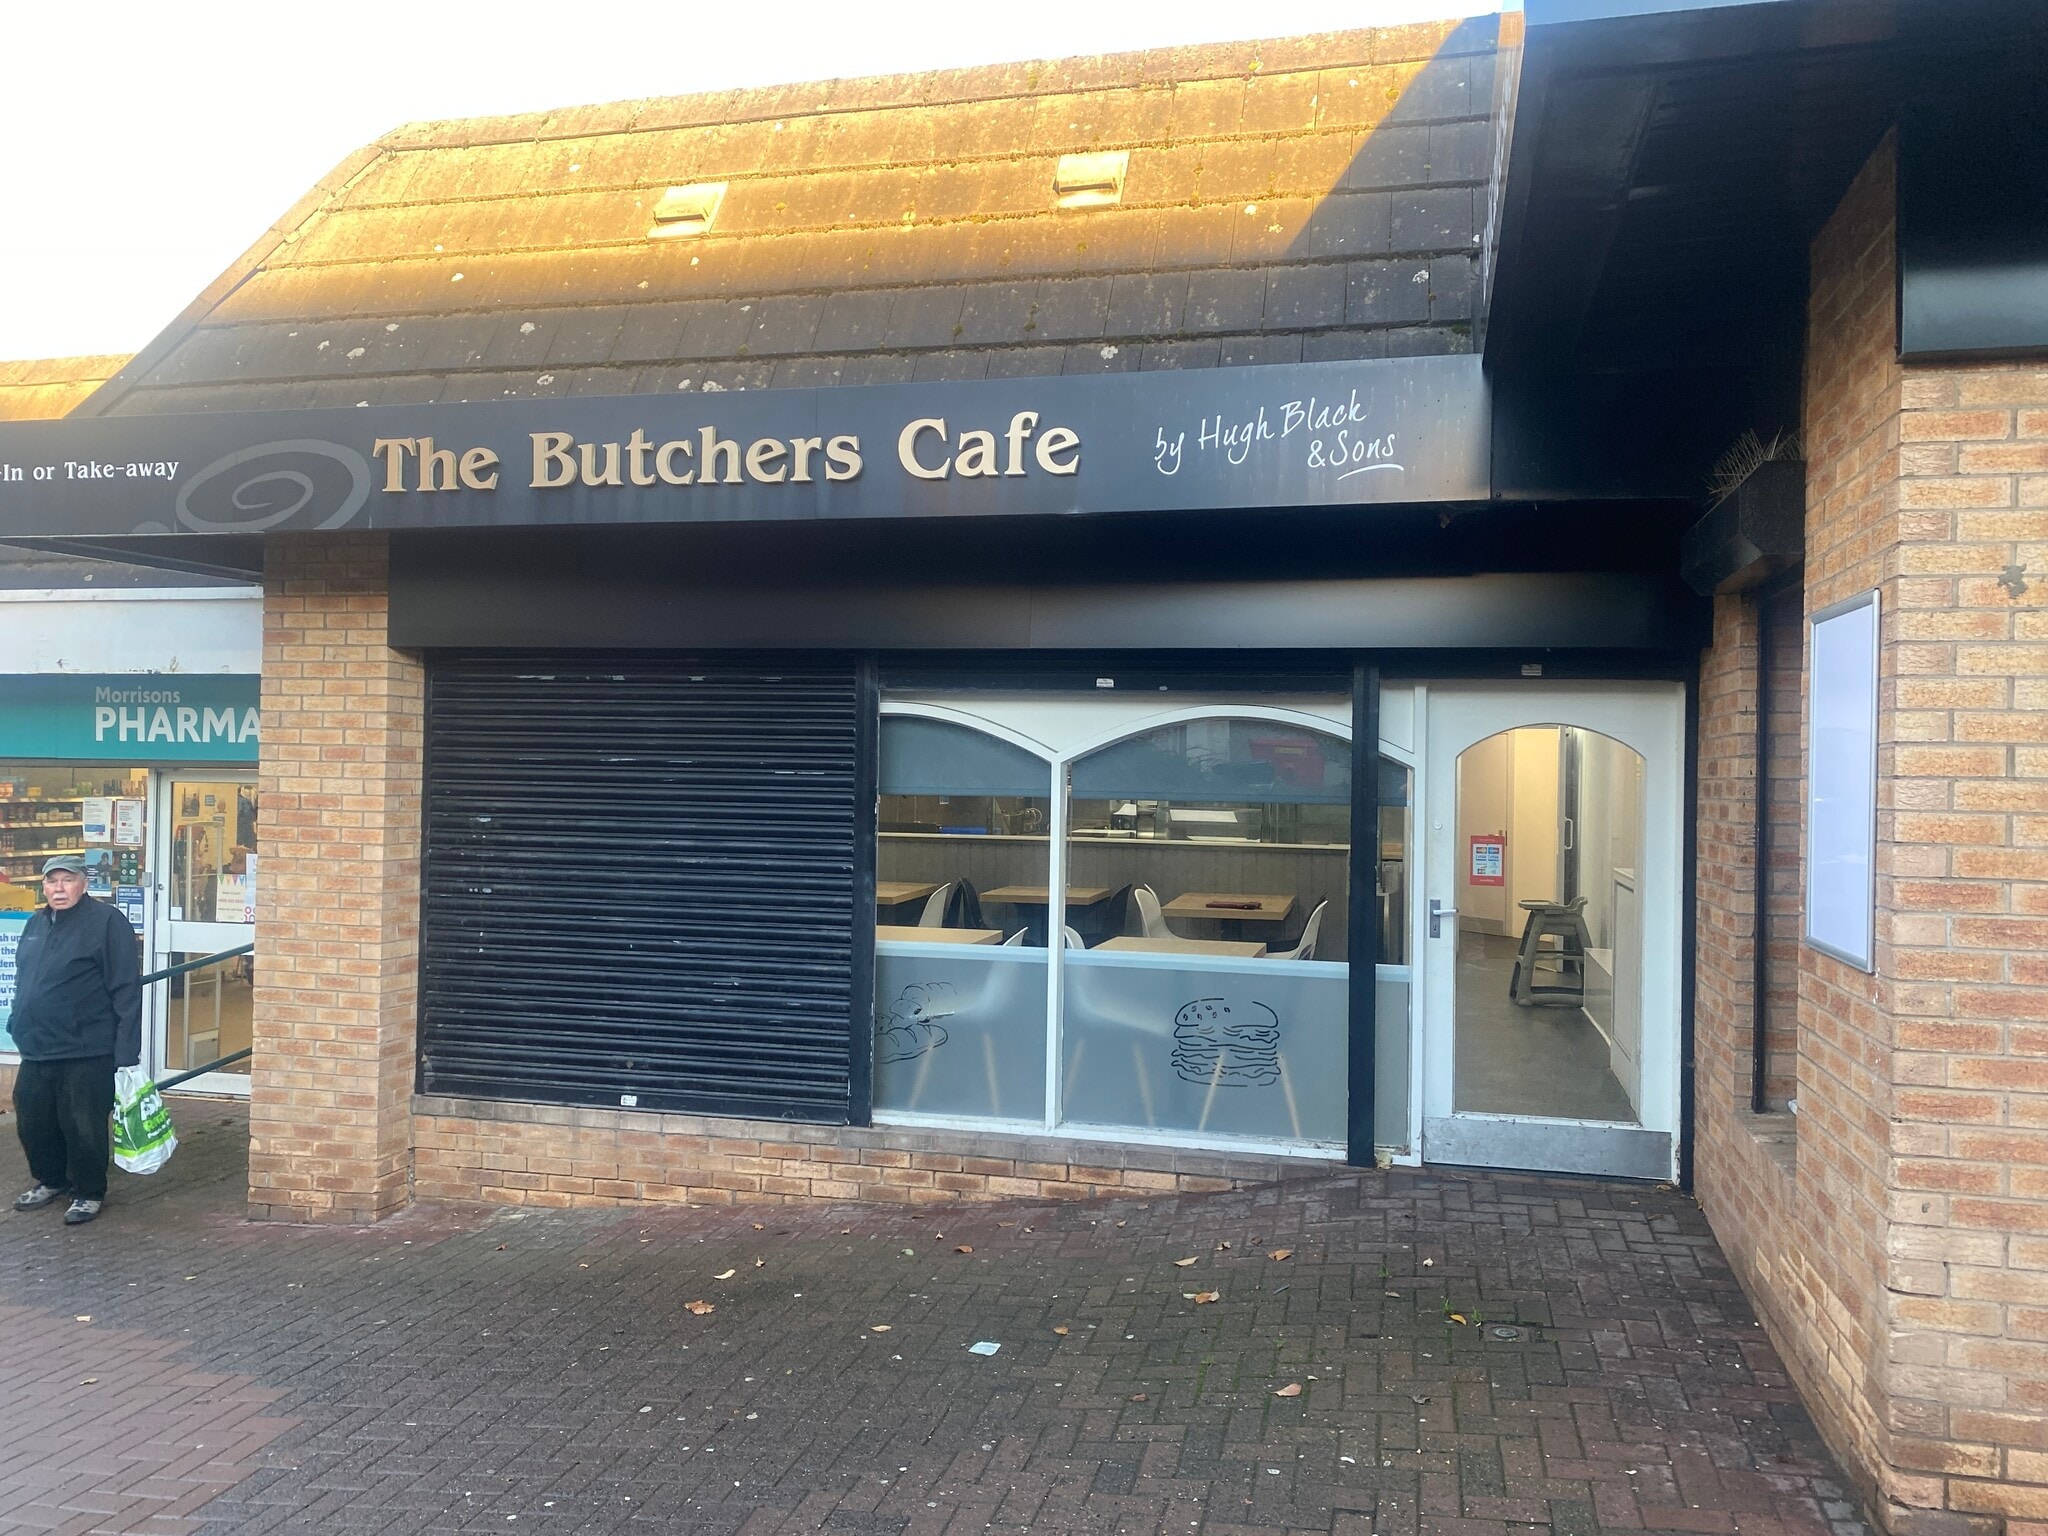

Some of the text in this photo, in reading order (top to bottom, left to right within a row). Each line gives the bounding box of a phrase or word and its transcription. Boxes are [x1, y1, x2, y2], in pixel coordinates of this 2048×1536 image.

[1154, 388, 1367, 475] by Hugh Black
[372, 411, 1081, 493] The Butchers Cafe
[0, 461, 179, 481] In or Take-away
[95, 686, 181, 704] Morrisons
[1, 946, 16, 955] the
